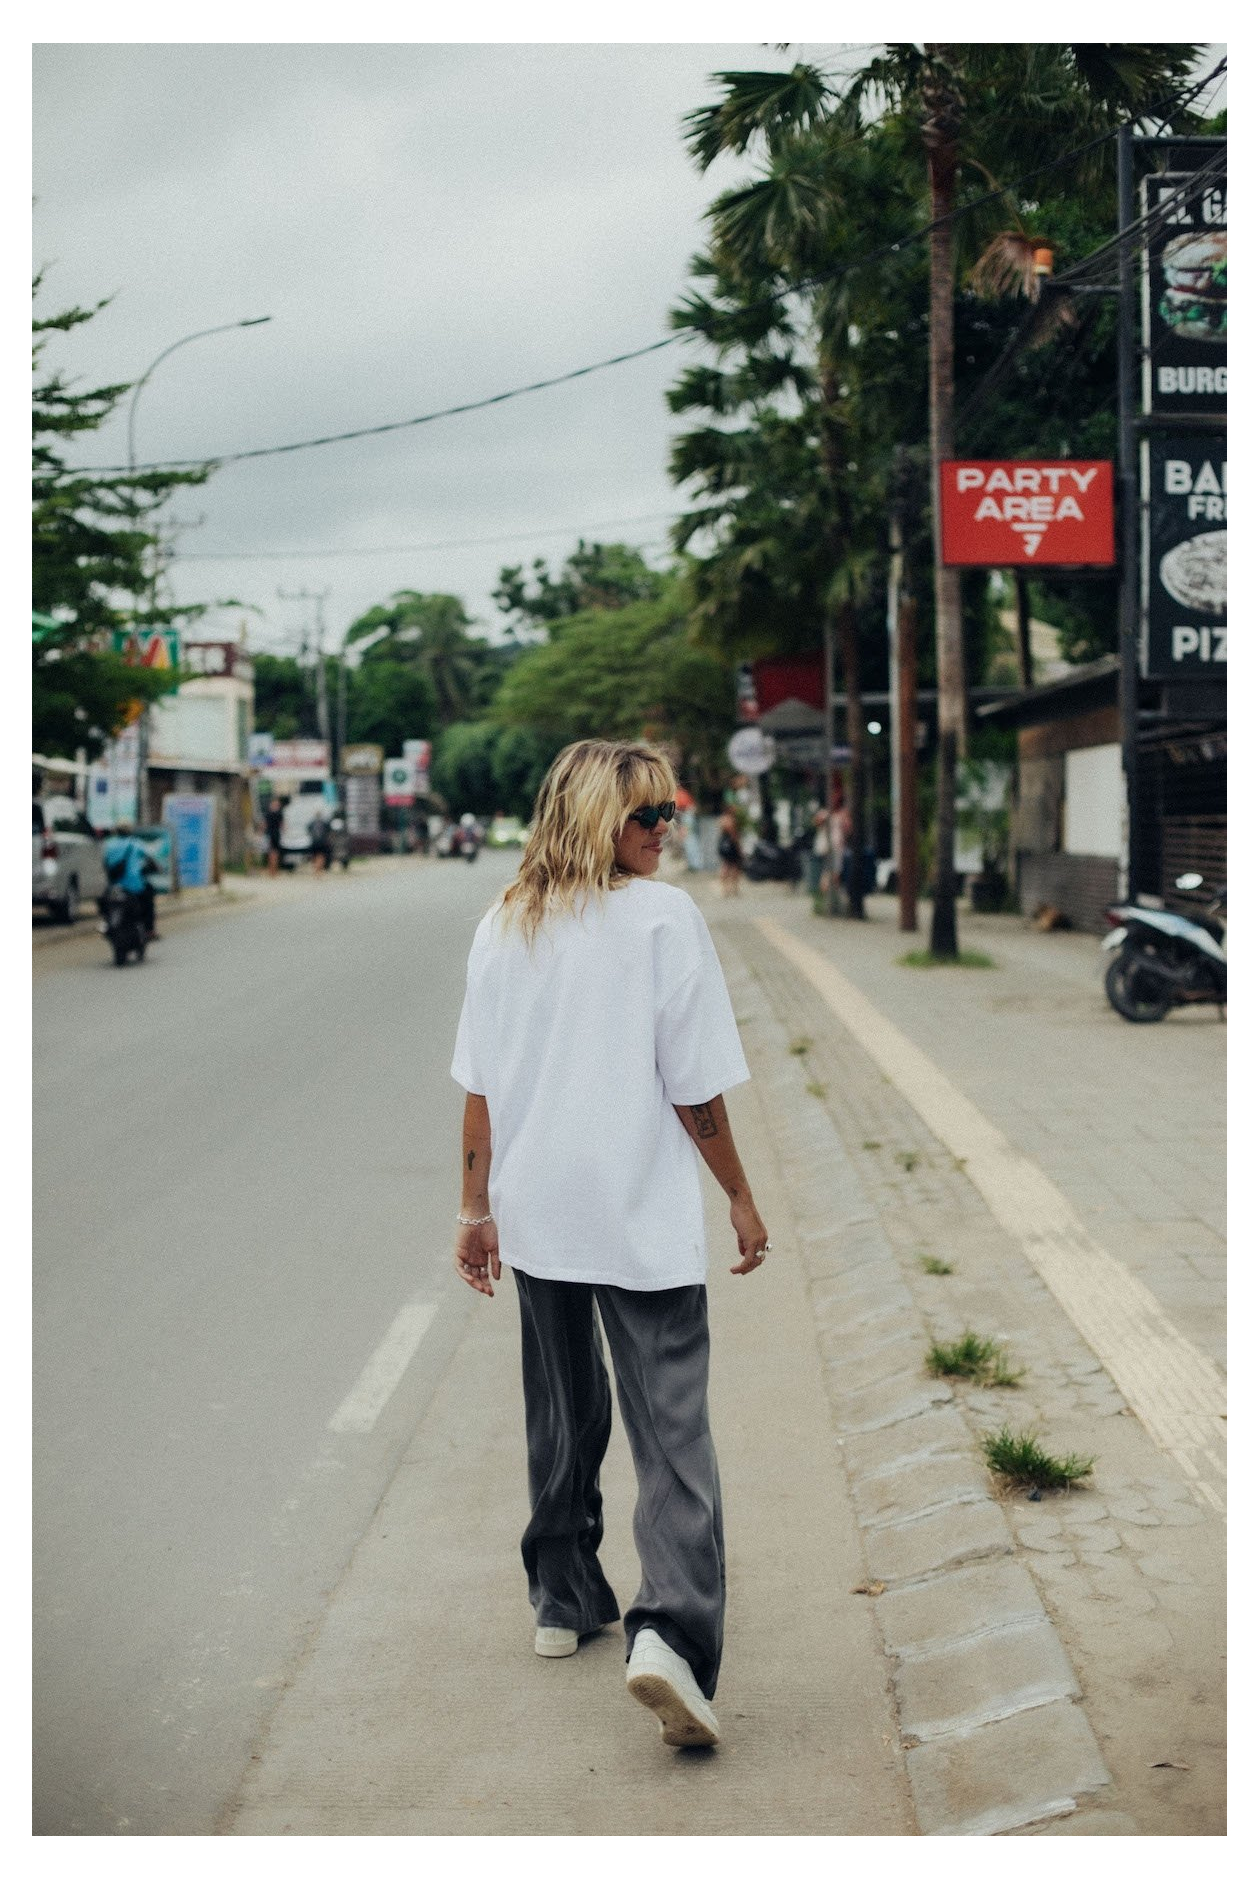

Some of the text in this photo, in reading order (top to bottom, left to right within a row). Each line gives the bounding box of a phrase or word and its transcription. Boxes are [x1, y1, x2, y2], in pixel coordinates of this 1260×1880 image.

[1202, 186, 1227, 225] G
[956, 467, 1098, 494] PARTY
[1164, 460, 1227, 495] BA
[974, 496, 1085, 522] AREA
[1187, 495, 1227, 520] FR
[1172, 626, 1227, 662] PIZ
